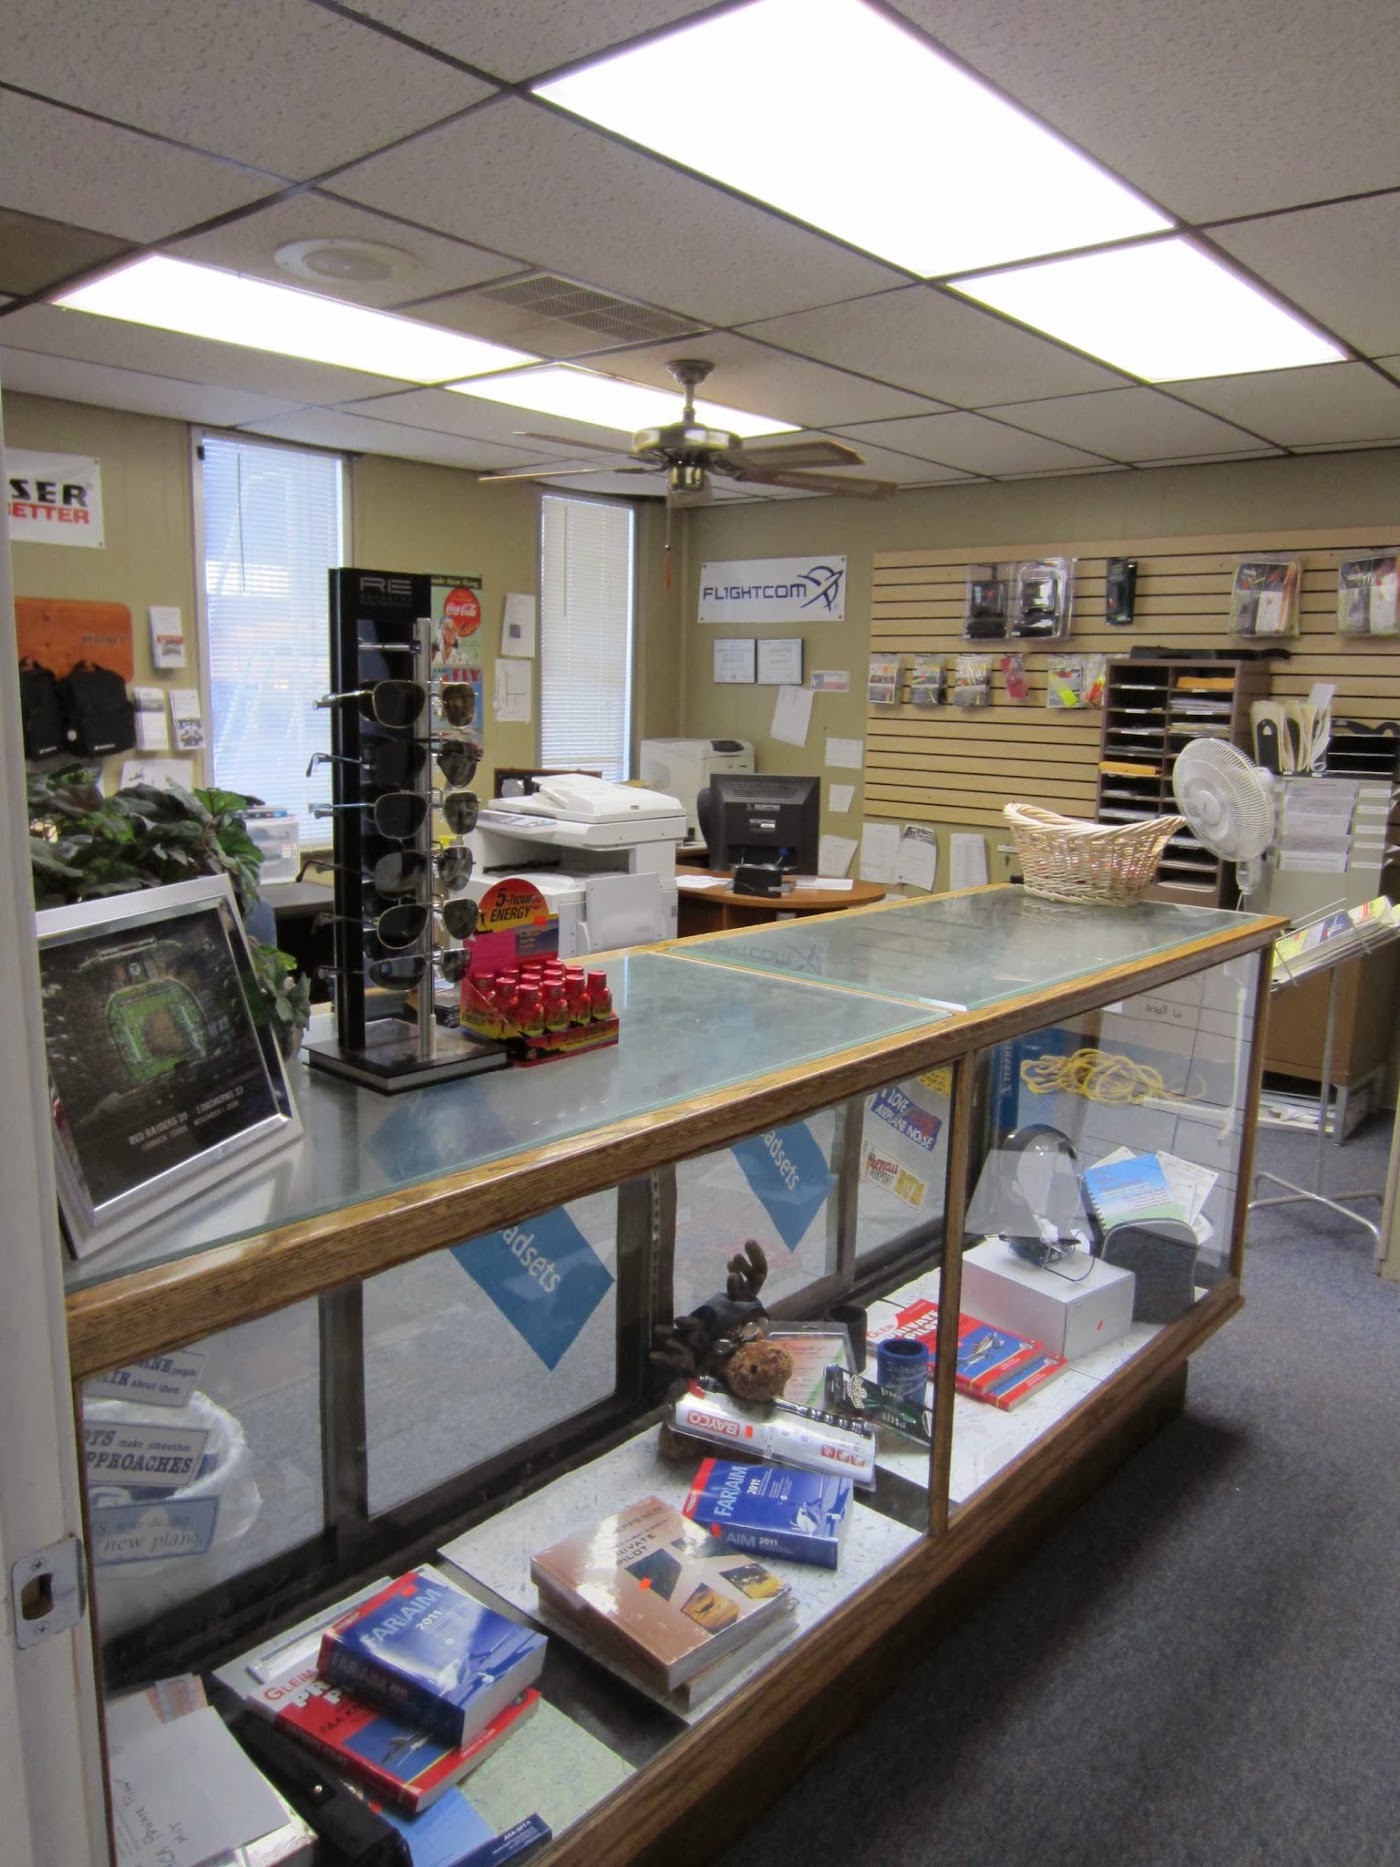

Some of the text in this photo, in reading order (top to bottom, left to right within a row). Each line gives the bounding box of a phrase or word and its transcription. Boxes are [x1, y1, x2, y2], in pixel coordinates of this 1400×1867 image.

[9, 478, 88, 507] SER
[8, 501, 89, 525] ETTER
[703, 583, 807, 600] FLIGHTCOM
[490, 905, 532, 922] ENERGY
[887, 1088, 910, 1112] LOVE
[875, 1103, 934, 1149] AIRPLANE NOISE
[761, 1130, 800, 1190] adsets
[499, 1226, 561, 1293] adsets
[688, 1411, 740, 1436] BAYCO
[119, 1440, 144, 1449] make
[148, 1443, 192, 1452] smoother
[86, 1451, 194, 1474] PPROACHES
[747, 1478, 761, 1495] 2011
[616, 1506, 662, 1533] EPPESEN
[616, 1533, 657, 1557] RIVATE
[726, 1532, 779, 1548] AIM 2011
[416, 1609, 443, 1630] 2011
[263, 1668, 314, 1700] GLEIM
